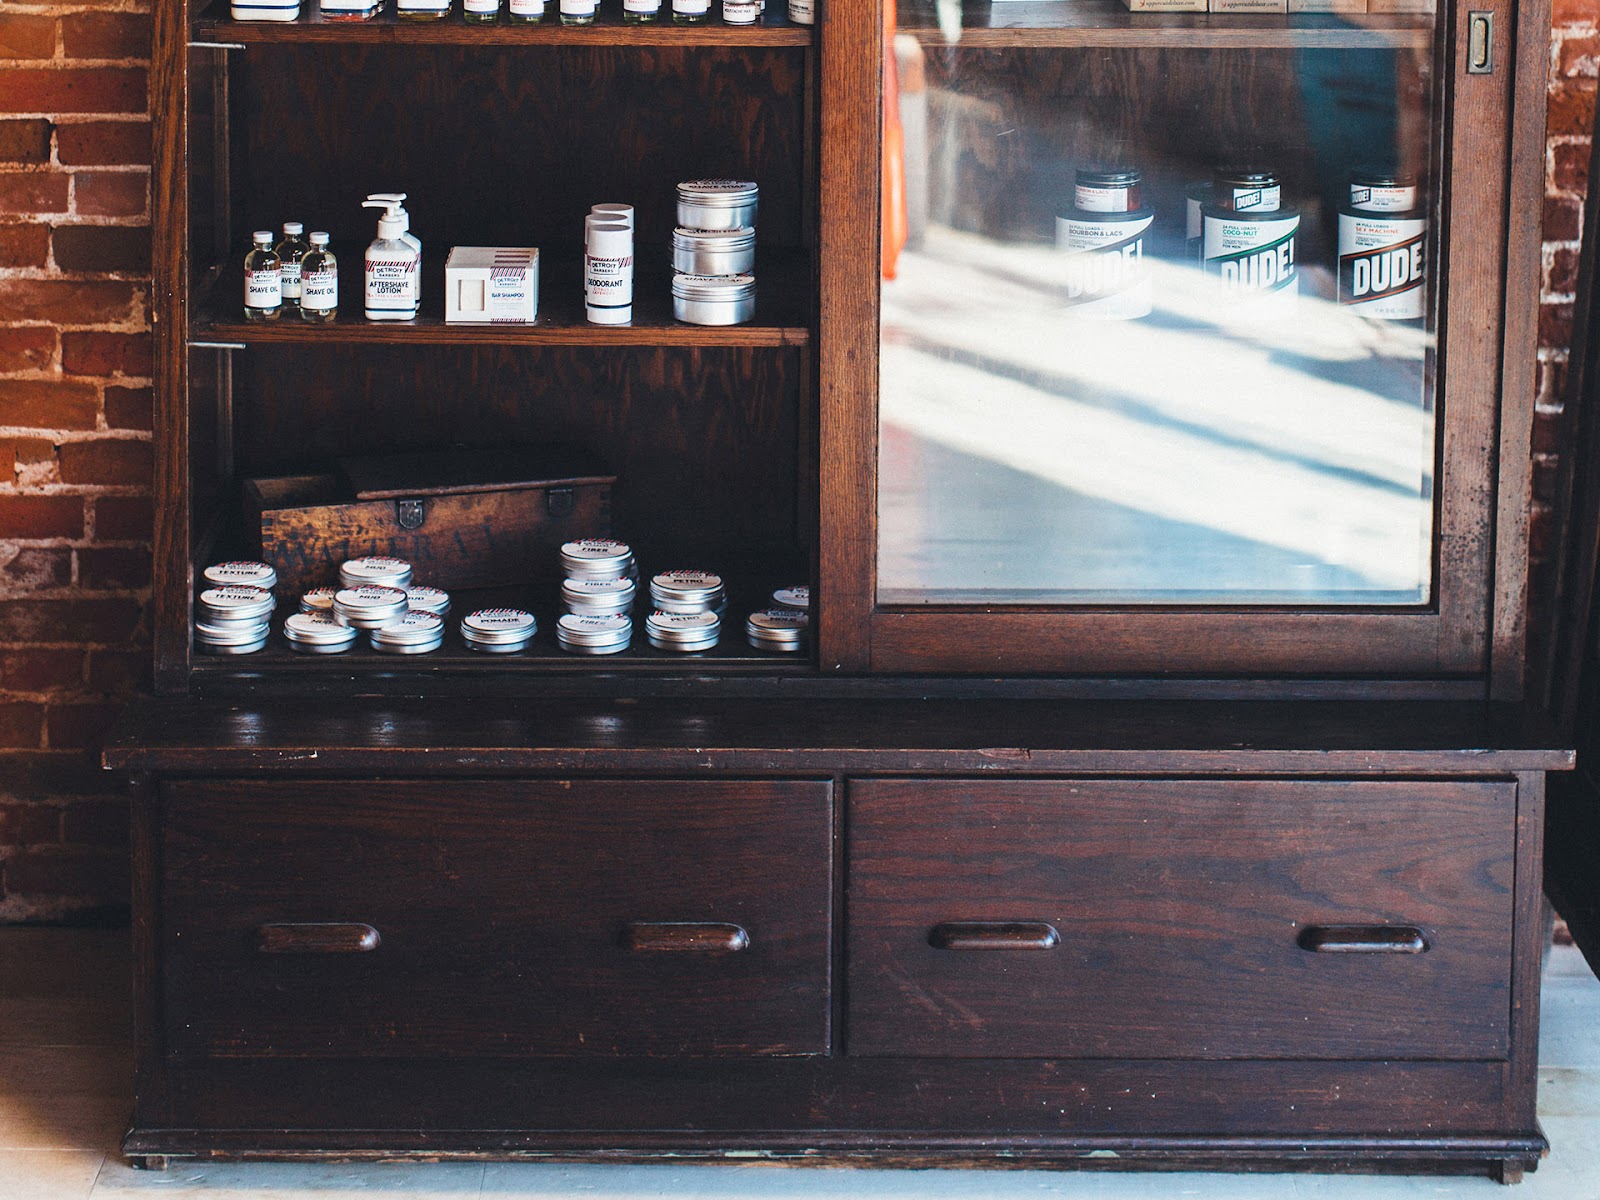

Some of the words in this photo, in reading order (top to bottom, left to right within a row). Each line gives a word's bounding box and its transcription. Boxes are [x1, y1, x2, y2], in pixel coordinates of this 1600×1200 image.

[1237, 191, 1260, 208] DUDE!
[1069, 228, 1099, 236] BOURBON
[1353, 240, 1423, 296] DUDE
[588, 278, 623, 287] DEODORANT
